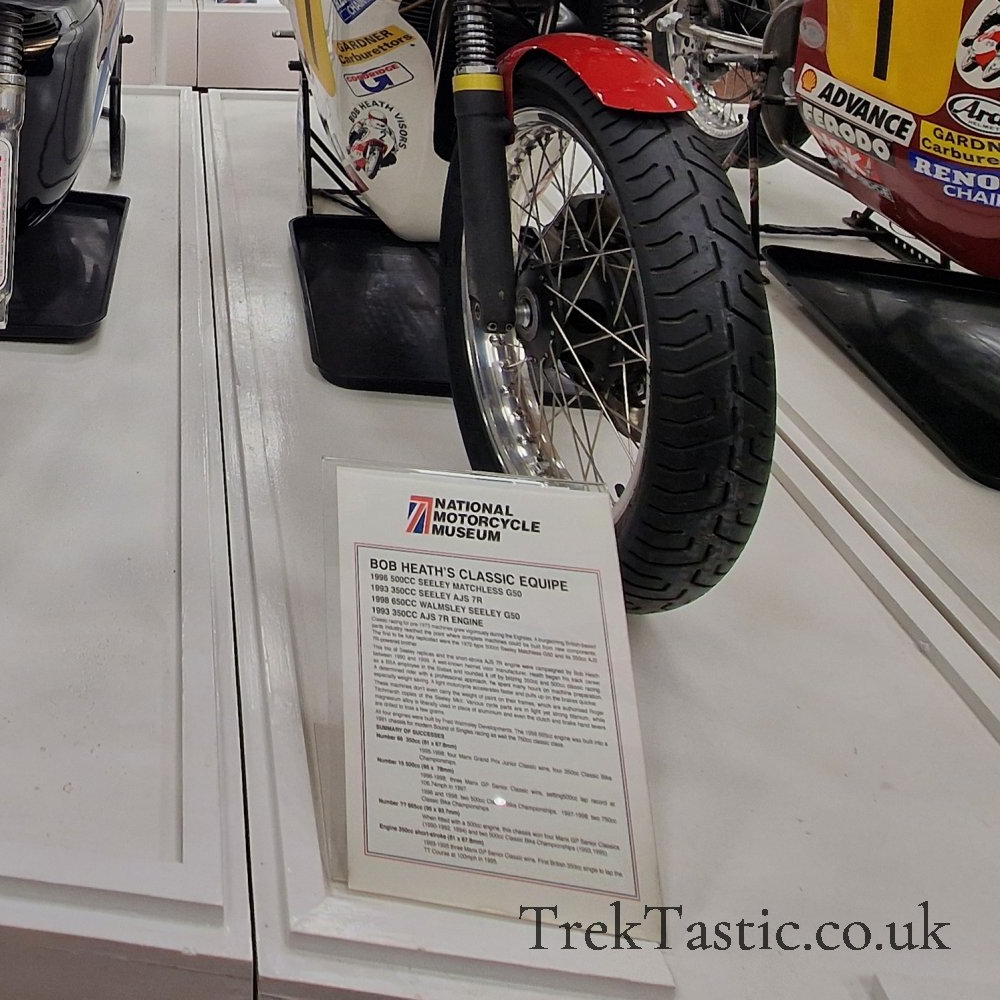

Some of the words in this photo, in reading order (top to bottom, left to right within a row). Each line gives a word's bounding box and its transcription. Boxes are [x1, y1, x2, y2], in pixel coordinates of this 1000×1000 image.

[337, 29, 393, 52] GARDNER
[339, 34, 413, 64] Carburettors
[818, 82, 913, 141] ADVANCE
[348, 106, 359, 124] BOB
[359, 100, 394, 112] HEATH
[394, 112, 408, 150] VISORS
[803, 102, 891, 162] FERODO
[435, 498, 513, 516] NATIONAL
[432, 525, 501, 542] MUSEUM
[434, 512, 540, 533] MOTORCYCLE
[369, 558, 397, 571] BOB
[401, 562, 455, 578] HEATH'S
[458, 568, 514, 585] CLASSIC
[518, 575, 568, 591] EQUIPE
[390, 575, 415, 585] 500CC
[417, 578, 450, 589] SEELEY
[452, 582, 503, 595] MATCHLESS
[505, 588, 522, 597] G50
[371, 584, 388, 593] 1993
[390, 586, 416, 596] 350CC
[418, 589, 451, 600] SEELEY
[453, 593, 469, 602] AJS
[472, 595, 482, 604] 7R
[371, 606, 389, 615] 1993
[391, 608, 417, 619] 350CC
[419, 612, 436, 621] AJS
[438, 614, 449, 623] 7R
[451, 615, 483, 627] ENGINE
[391, 597, 416, 607] 650CC
[419, 601, 466, 613] WALMSLEY
[468, 606, 501, 617] SEELEY
[503, 610, 520, 620] G50
